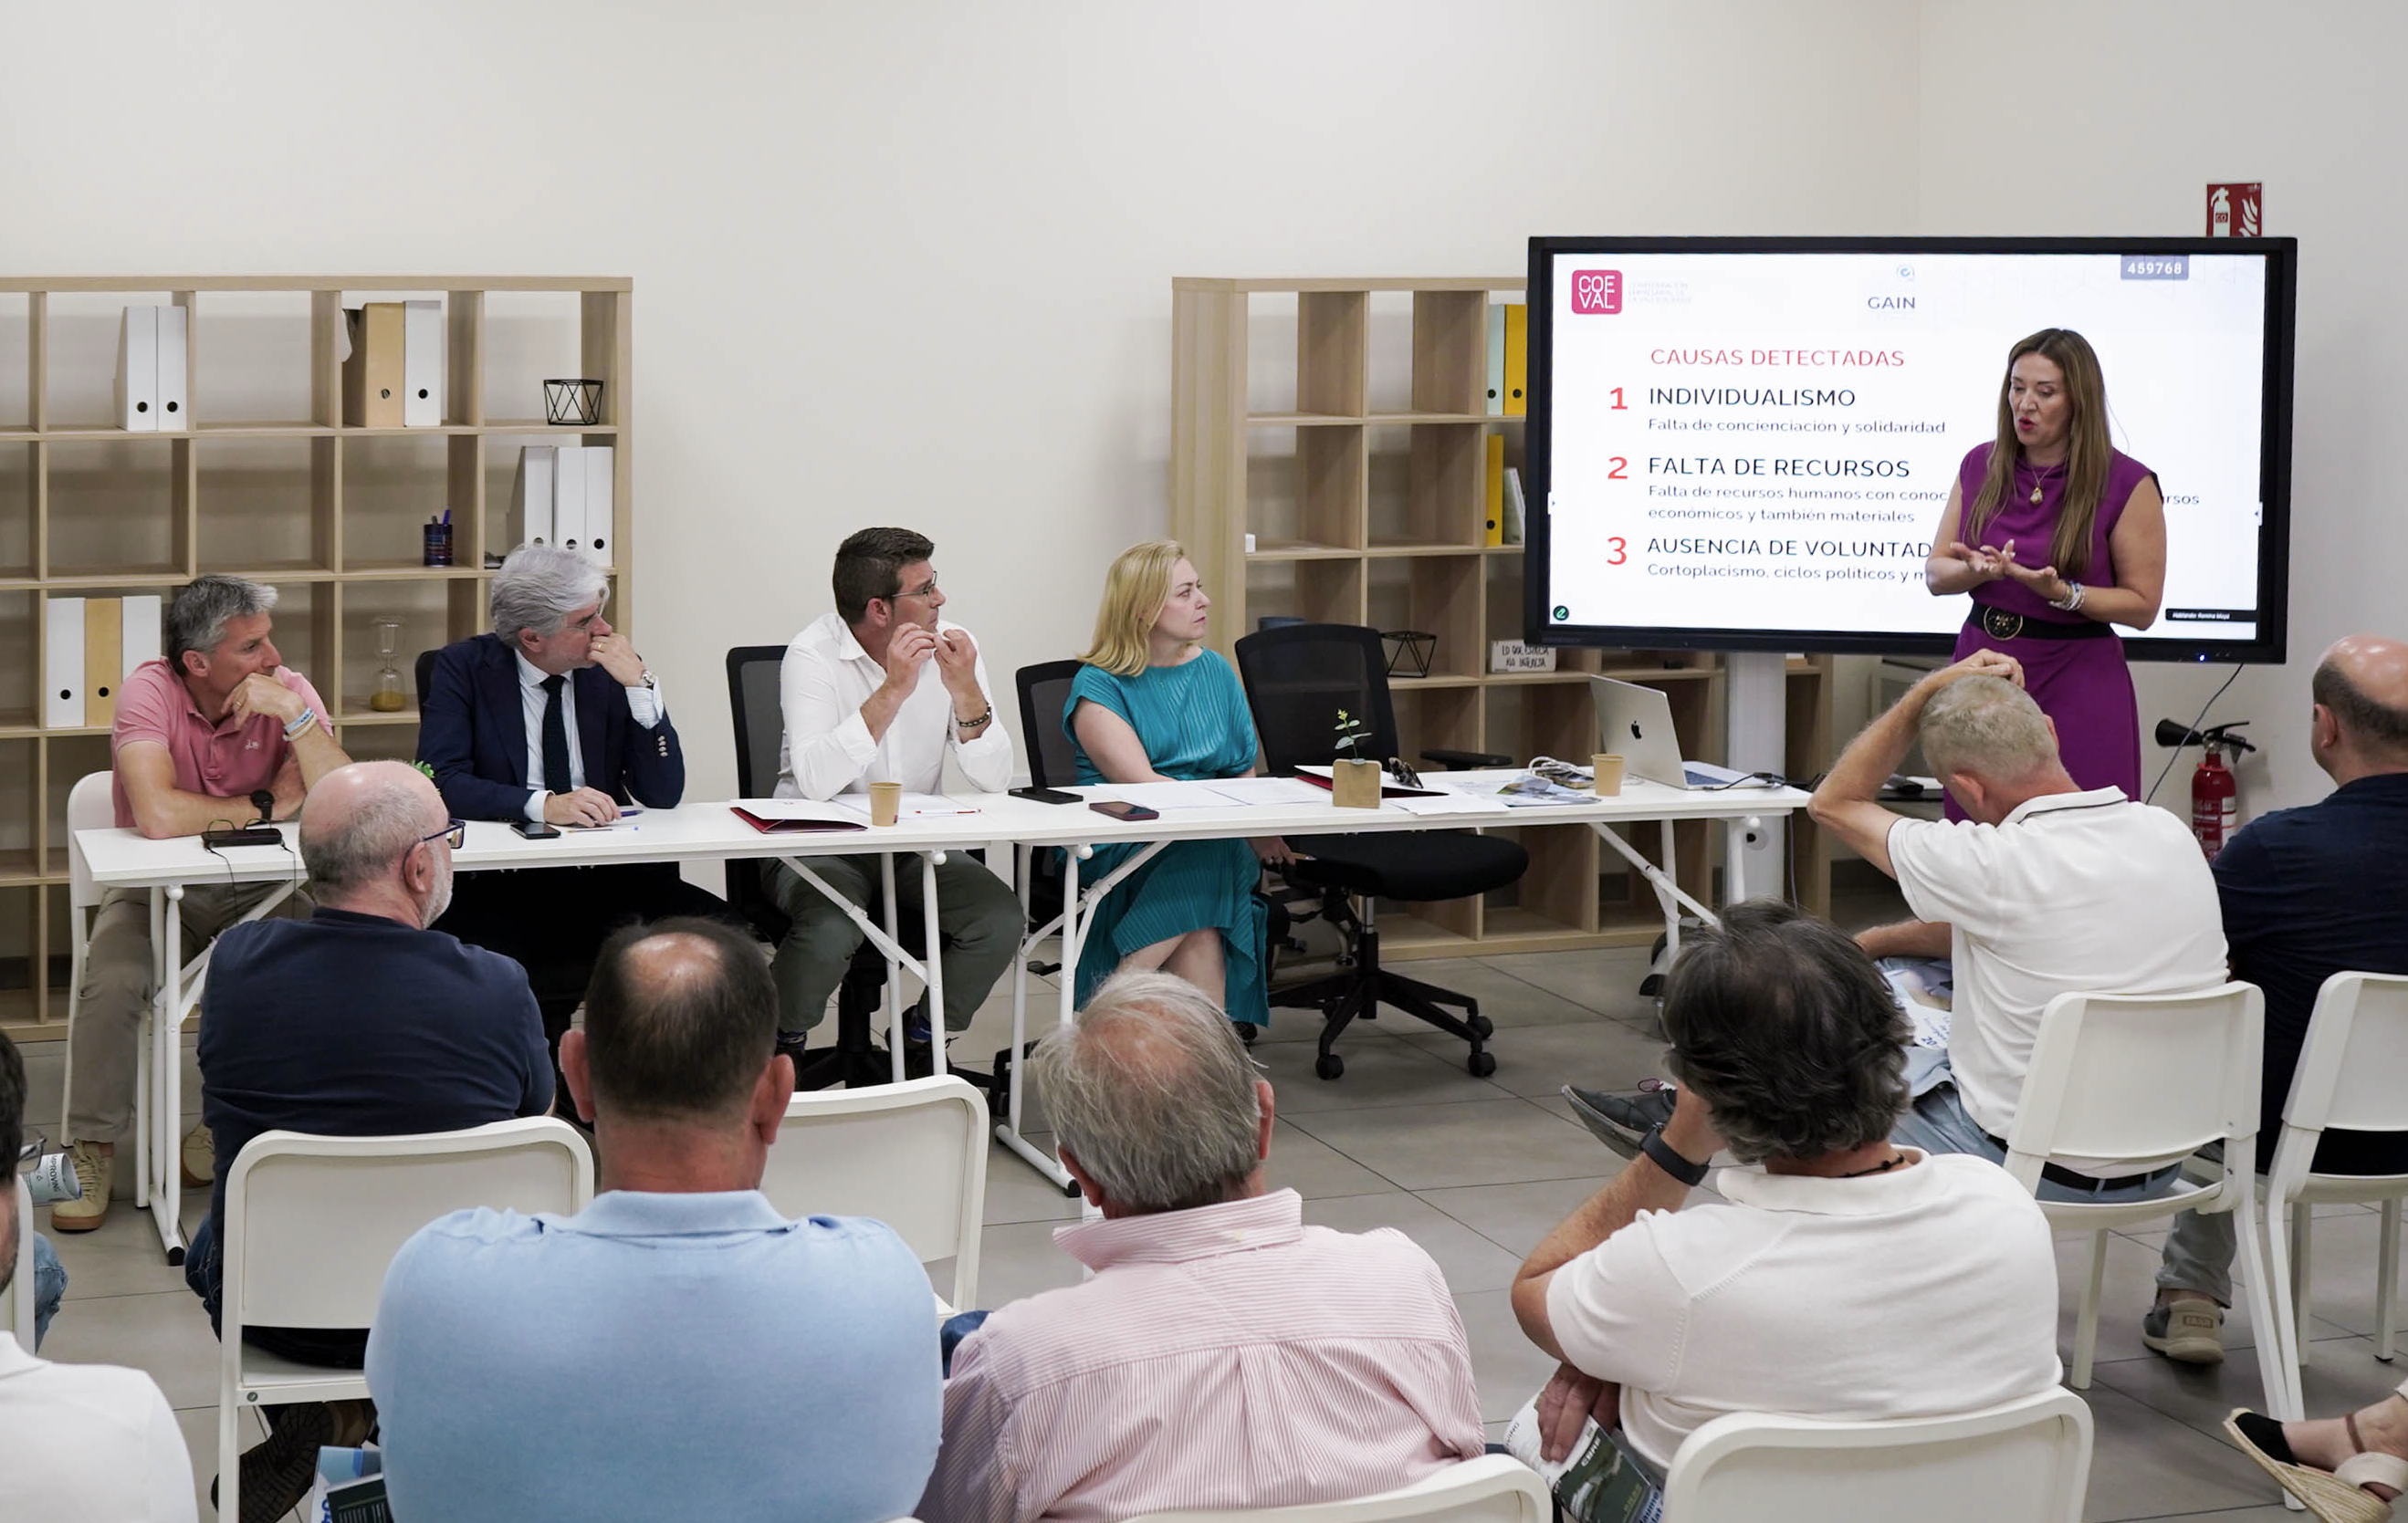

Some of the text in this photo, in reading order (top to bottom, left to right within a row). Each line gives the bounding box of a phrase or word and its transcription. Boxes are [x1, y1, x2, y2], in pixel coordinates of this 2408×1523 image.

[2127, 261, 2183, 275] 459768
[1578, 276, 1616, 293] COE
[1578, 292, 1616, 309] VAL
[1868, 296, 1916, 309] GAIN
[1650, 349, 1905, 367] CAUSAS DETECTADAS
[1609, 386, 1856, 411] 1 INDIVIDUALISMO
[1649, 418, 1688, 431] Falta
[1691, 418, 1712, 431] de
[1842, 423, 1850, 436] y
[1855, 420, 1946, 433] solidaridad
[1607, 455, 1911, 480] 2 FALTA DE RECURSOS
[1649, 485, 2200, 505] Falta de recursos humanos con conoc rsos
[1648, 507, 1915, 524] económicos y también materiales
[1606, 536, 1932, 566] 3 AUSENCIA DE VOLUNTAD
[1774, 566, 1821, 579] ciclos
[1900, 571, 1909, 584] y
